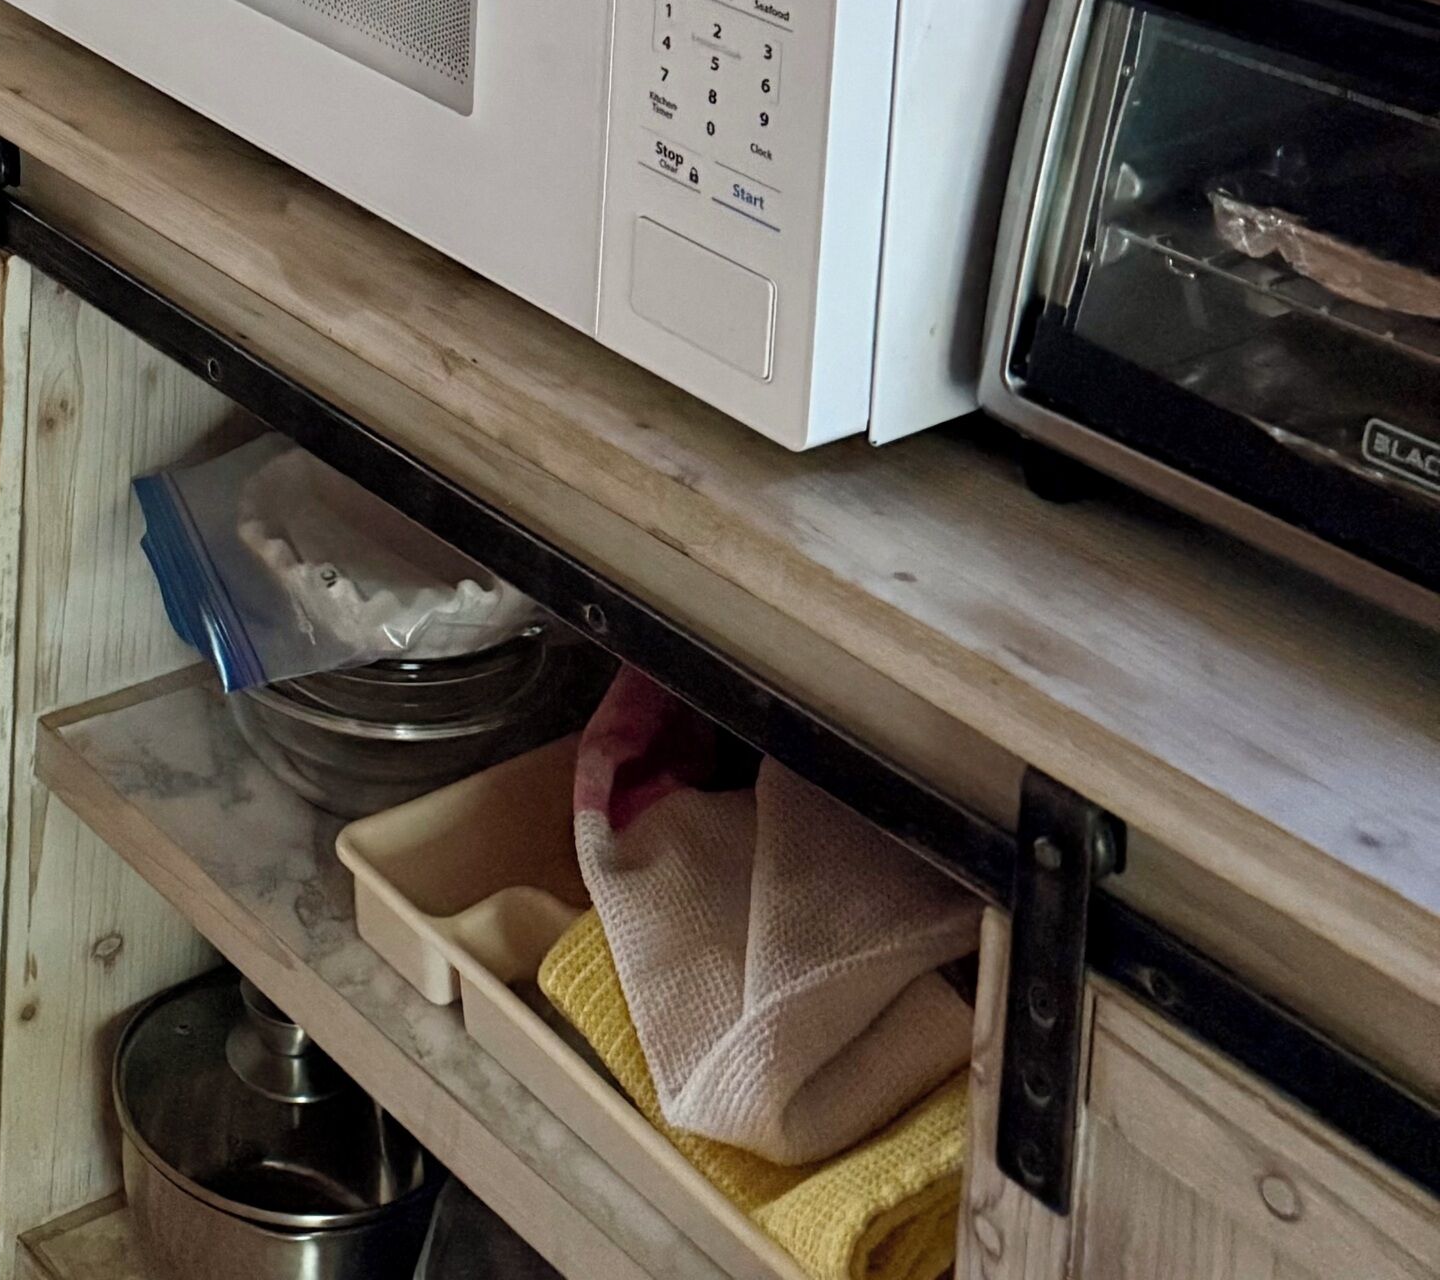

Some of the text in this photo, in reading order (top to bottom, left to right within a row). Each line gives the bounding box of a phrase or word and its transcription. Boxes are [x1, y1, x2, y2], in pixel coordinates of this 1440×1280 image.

[665, 3, 672, 18] 1
[754, 0, 790, 21] Seafood
[713, 23, 722, 39] 2
[662, 35, 671, 50] 4
[763, 44, 773, 60] 3
[710, 56, 720, 71] 5
[660, 66, 669, 81] 7
[761, 78, 771, 94] 6
[649, 91, 678, 111] Kitchen
[708, 89, 717, 105] 8
[652, 102, 673, 120] Timer
[759, 112, 769, 127] 9
[706, 120, 715, 136] 0
[655, 141, 684, 166] Stop
[750, 142, 773, 161] Clock
[659, 158, 678, 174] Clear
[732, 183, 765, 210] Start
